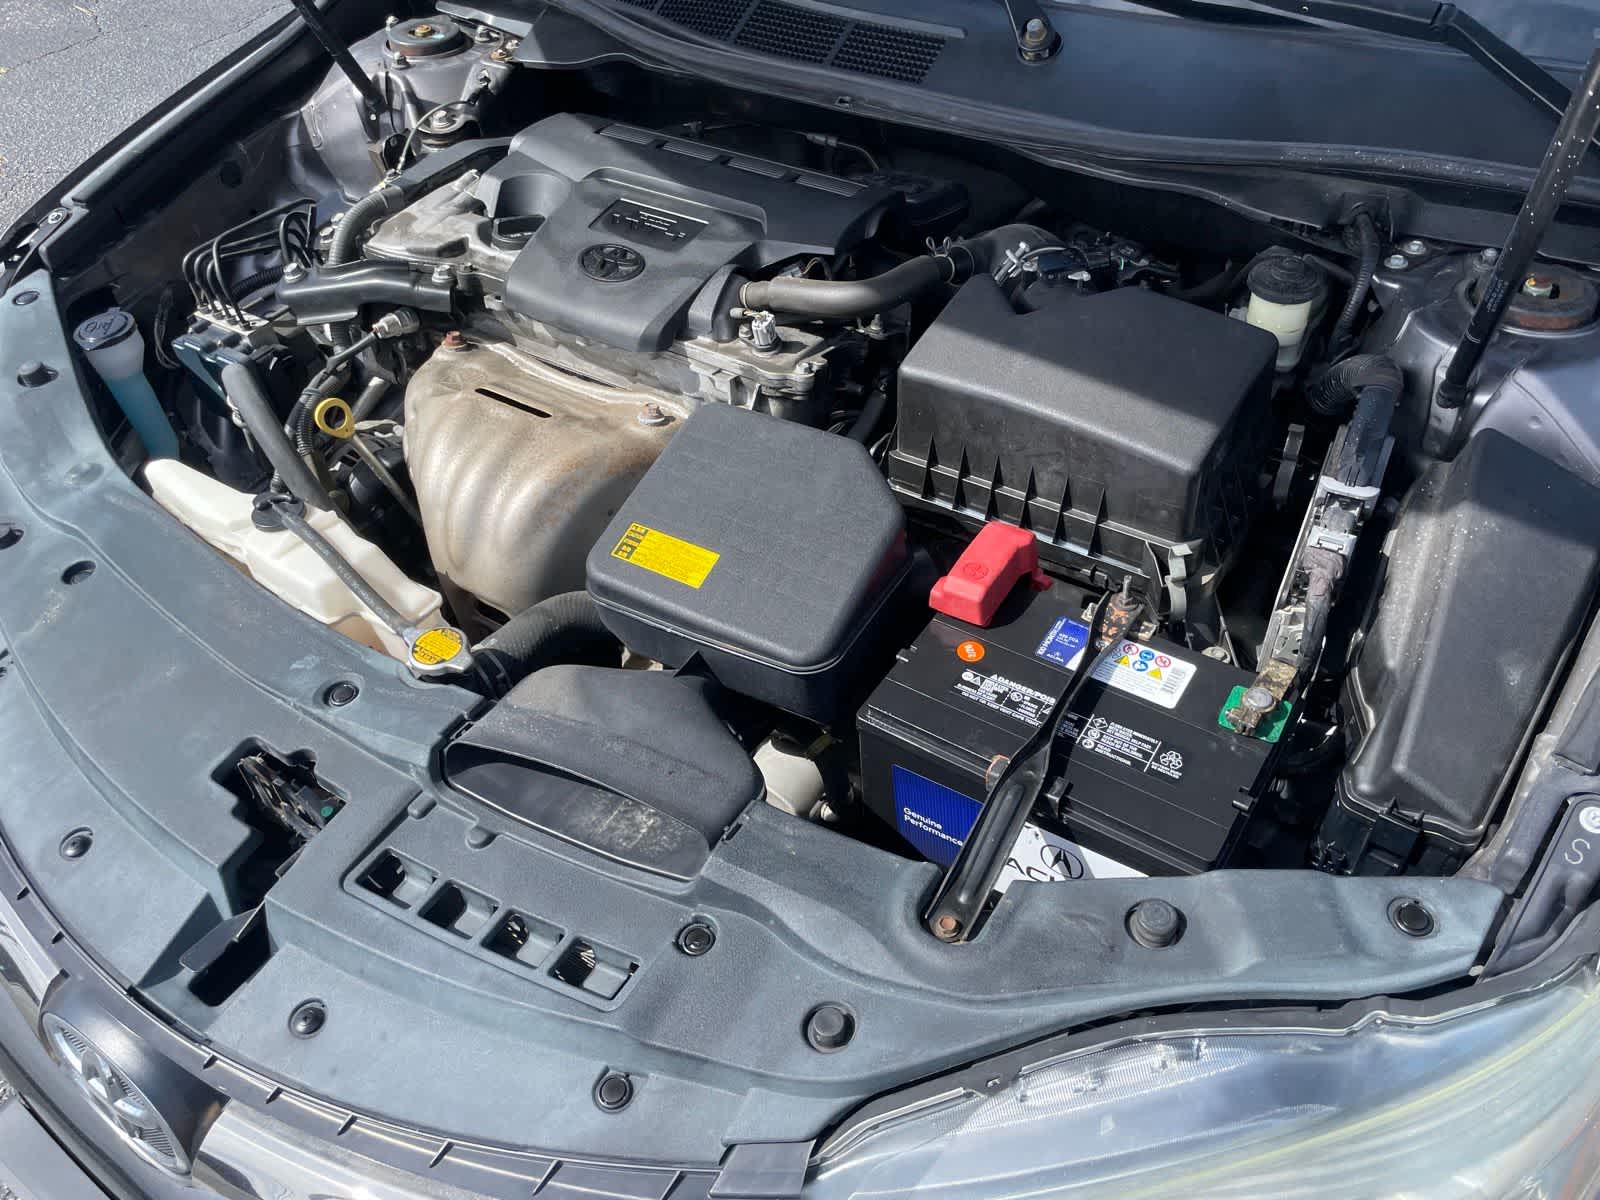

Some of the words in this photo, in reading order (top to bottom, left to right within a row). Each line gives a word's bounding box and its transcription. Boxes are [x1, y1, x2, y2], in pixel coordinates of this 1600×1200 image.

[996, 676, 1057, 704] DANGER/POIS
[903, 807, 943, 830] Genuine
[904, 814, 964, 847] Performance
